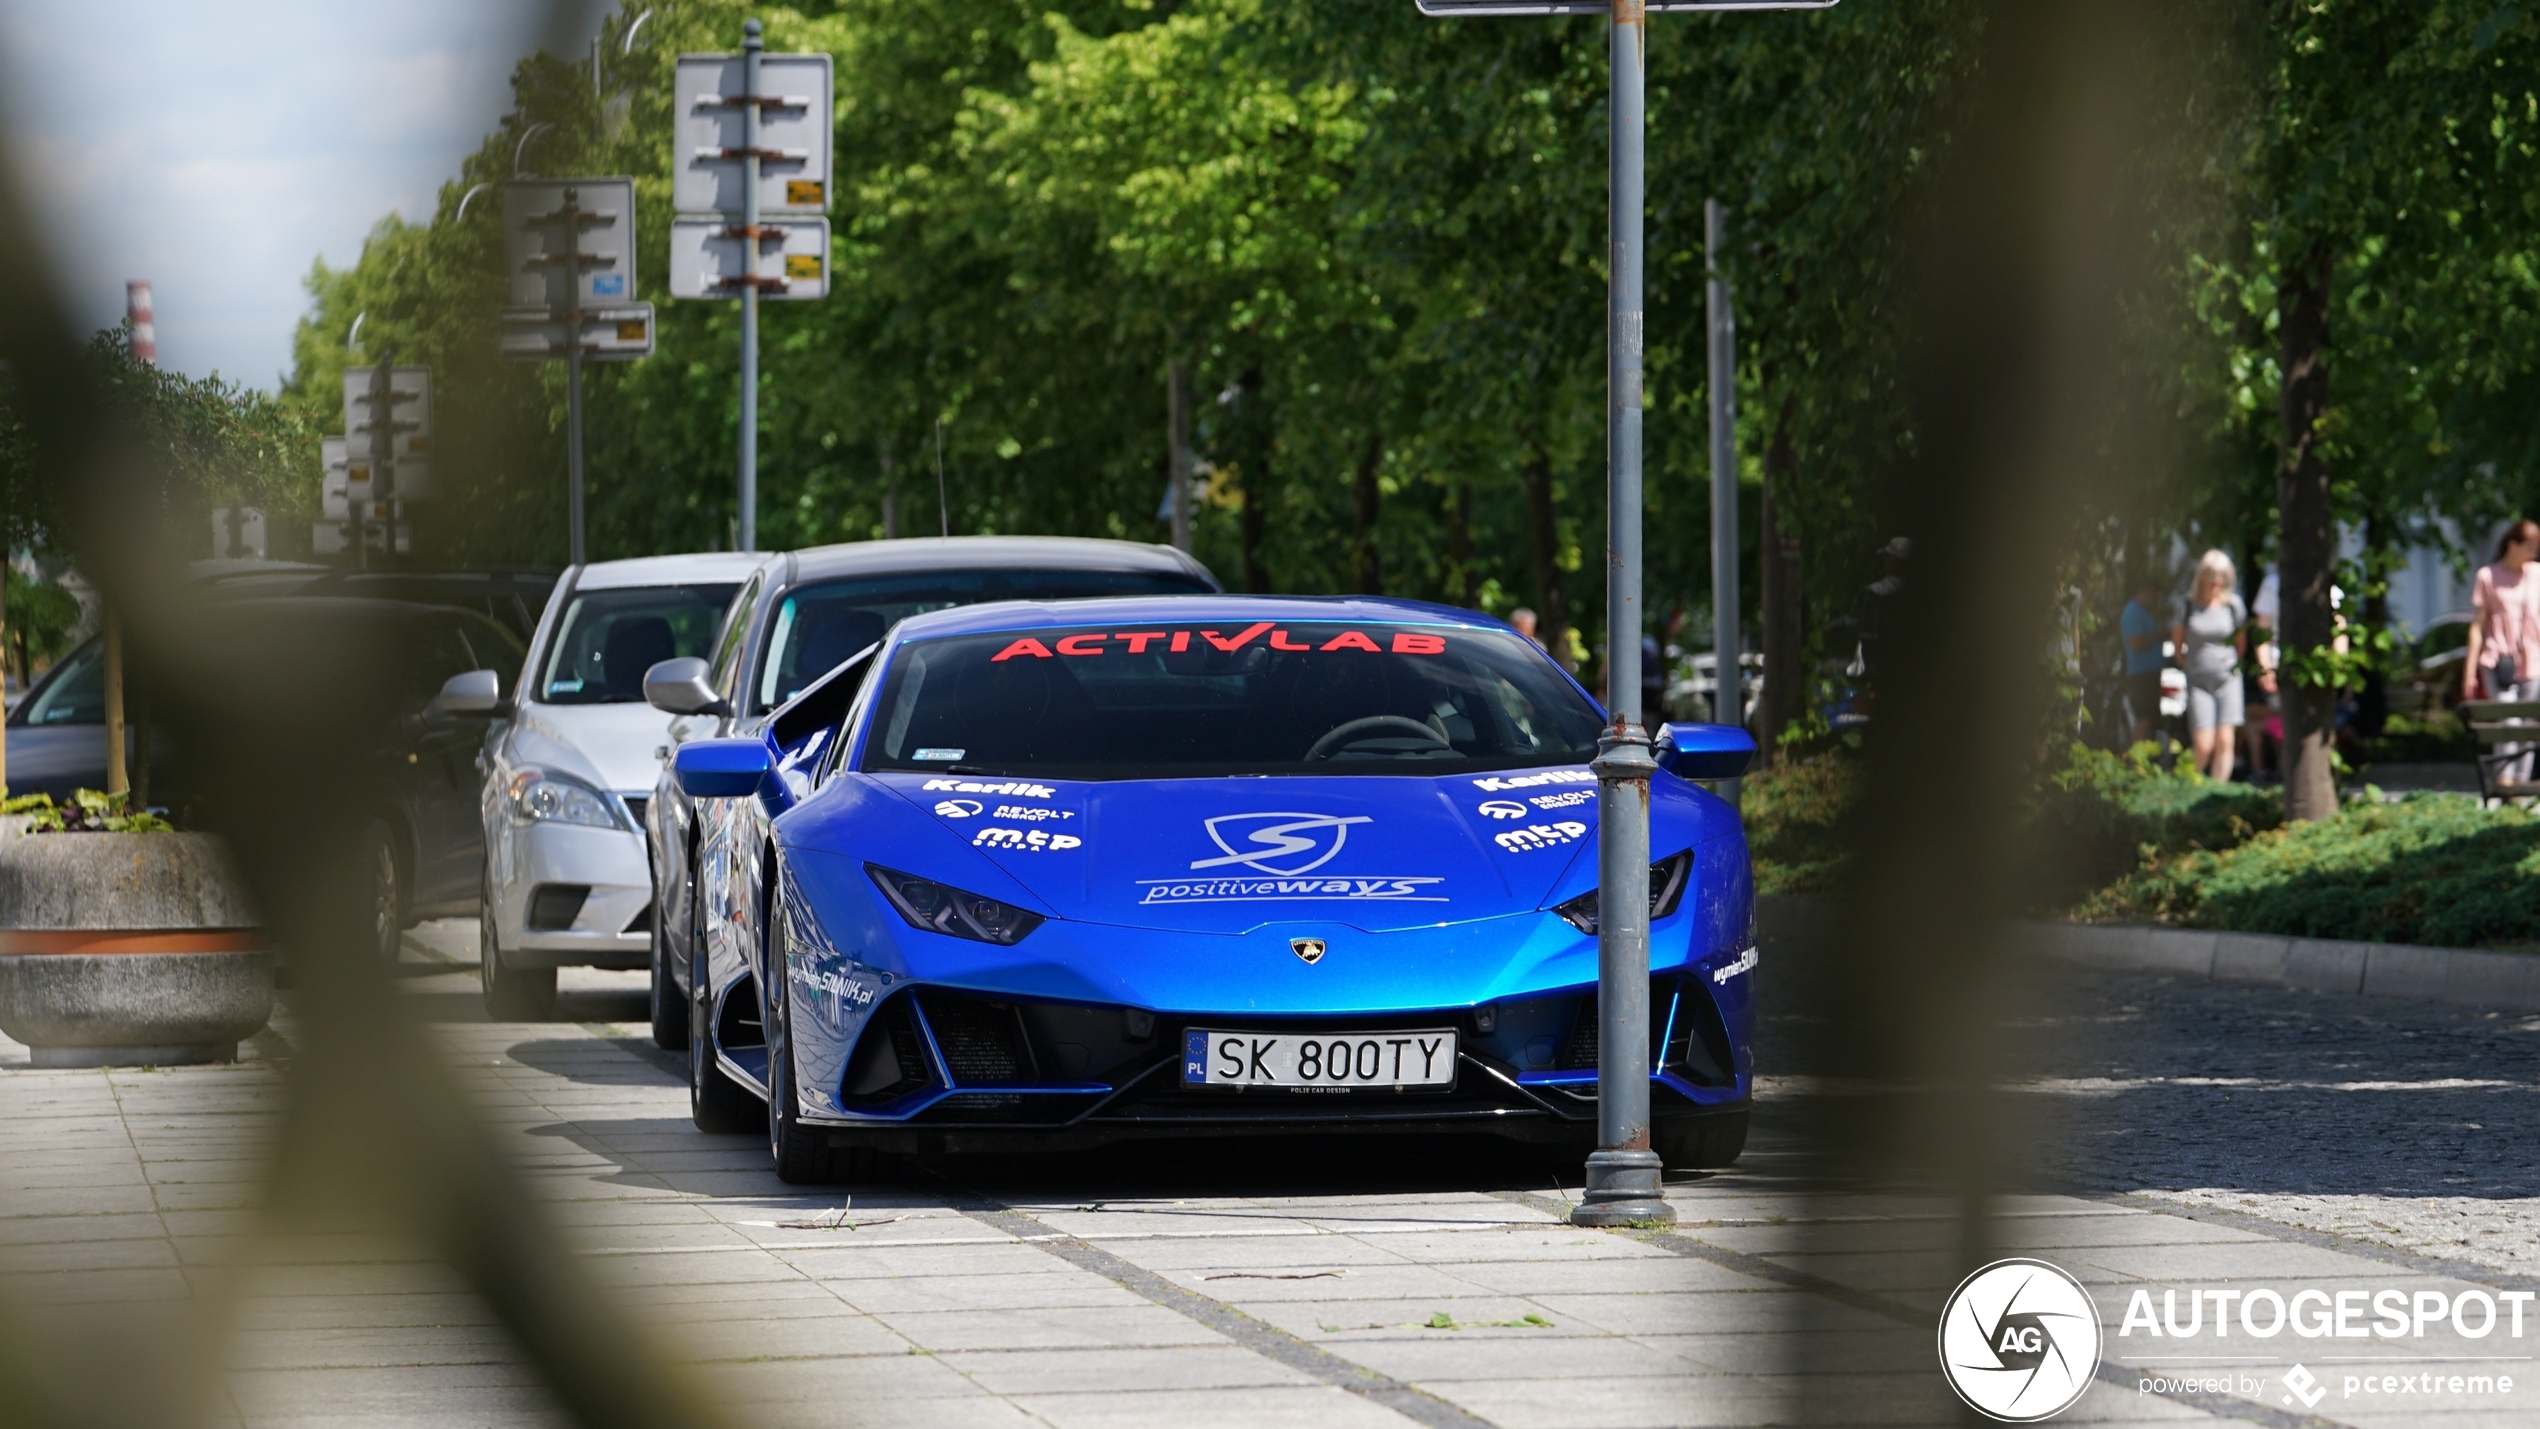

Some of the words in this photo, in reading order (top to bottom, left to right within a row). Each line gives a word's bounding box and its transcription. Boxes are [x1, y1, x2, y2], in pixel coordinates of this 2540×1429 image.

[991, 622, 1446, 661] ACTIVLAB
[922, 779, 1056, 799] Karlik
[1529, 790, 1596, 806] REVOLT
[1538, 798, 1586, 810] ENERGY
[993, 811, 1046, 822] ENERGY
[997, 805, 1075, 819] REVOLT
[977, 828, 1082, 850] mtp
[1494, 821, 1587, 848] mtp
[972, 839, 1040, 852] GRUPA
[1508, 837, 1571, 853] GRUPA
[1146, 879, 1441, 902] positiveways
[1218, 1038, 1277, 1080] SK
[1298, 1038, 1442, 1080] 800TY
[1188, 1062, 1204, 1075] PL
